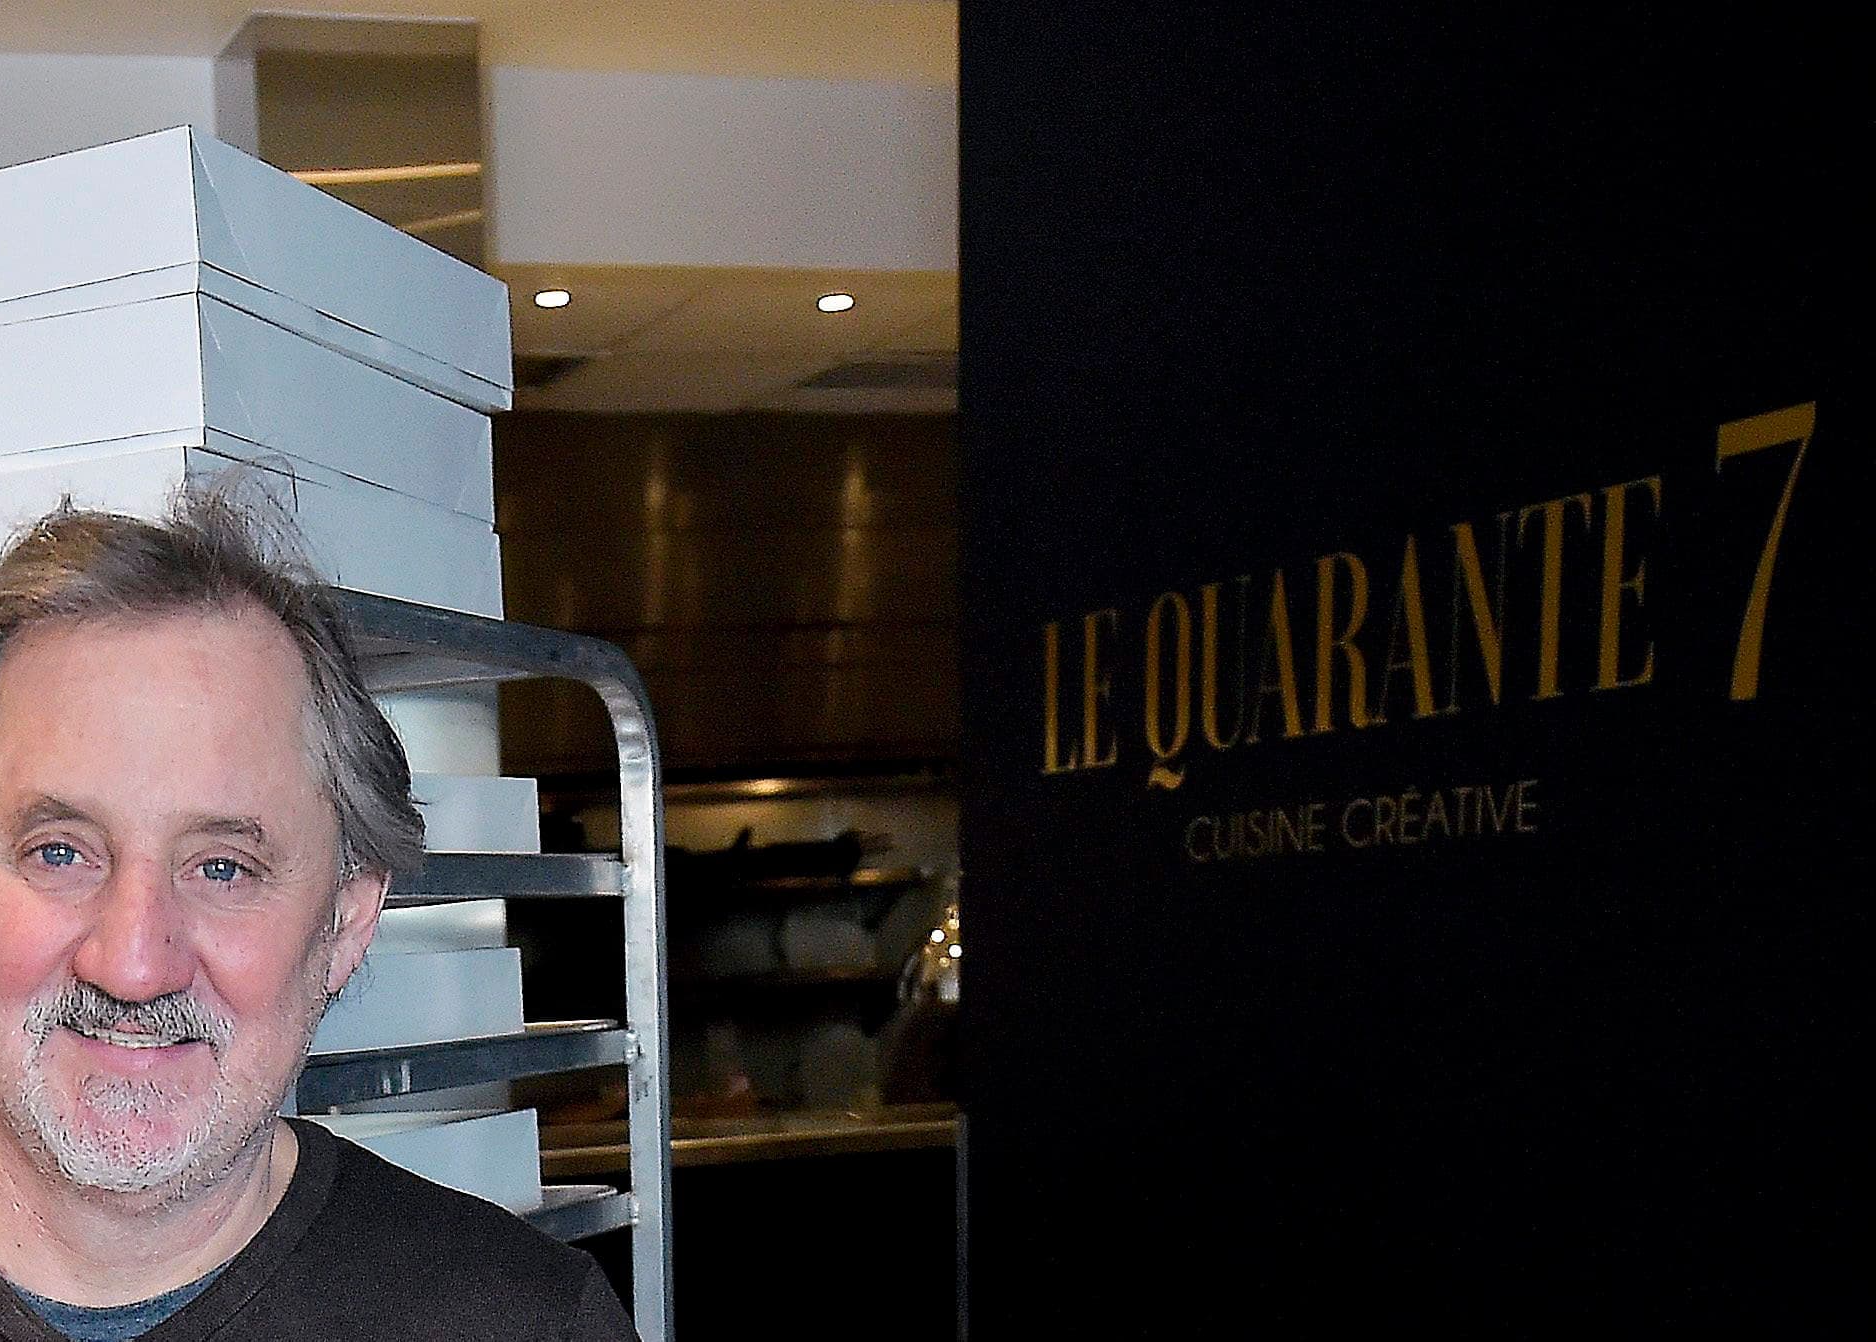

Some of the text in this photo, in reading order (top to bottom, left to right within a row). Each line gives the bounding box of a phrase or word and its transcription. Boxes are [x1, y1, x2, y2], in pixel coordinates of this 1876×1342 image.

[1041, 400, 1817, 791] LE QUARANTE 7
[1184, 778, 1541, 864] CUISINE CRÉATIVE
